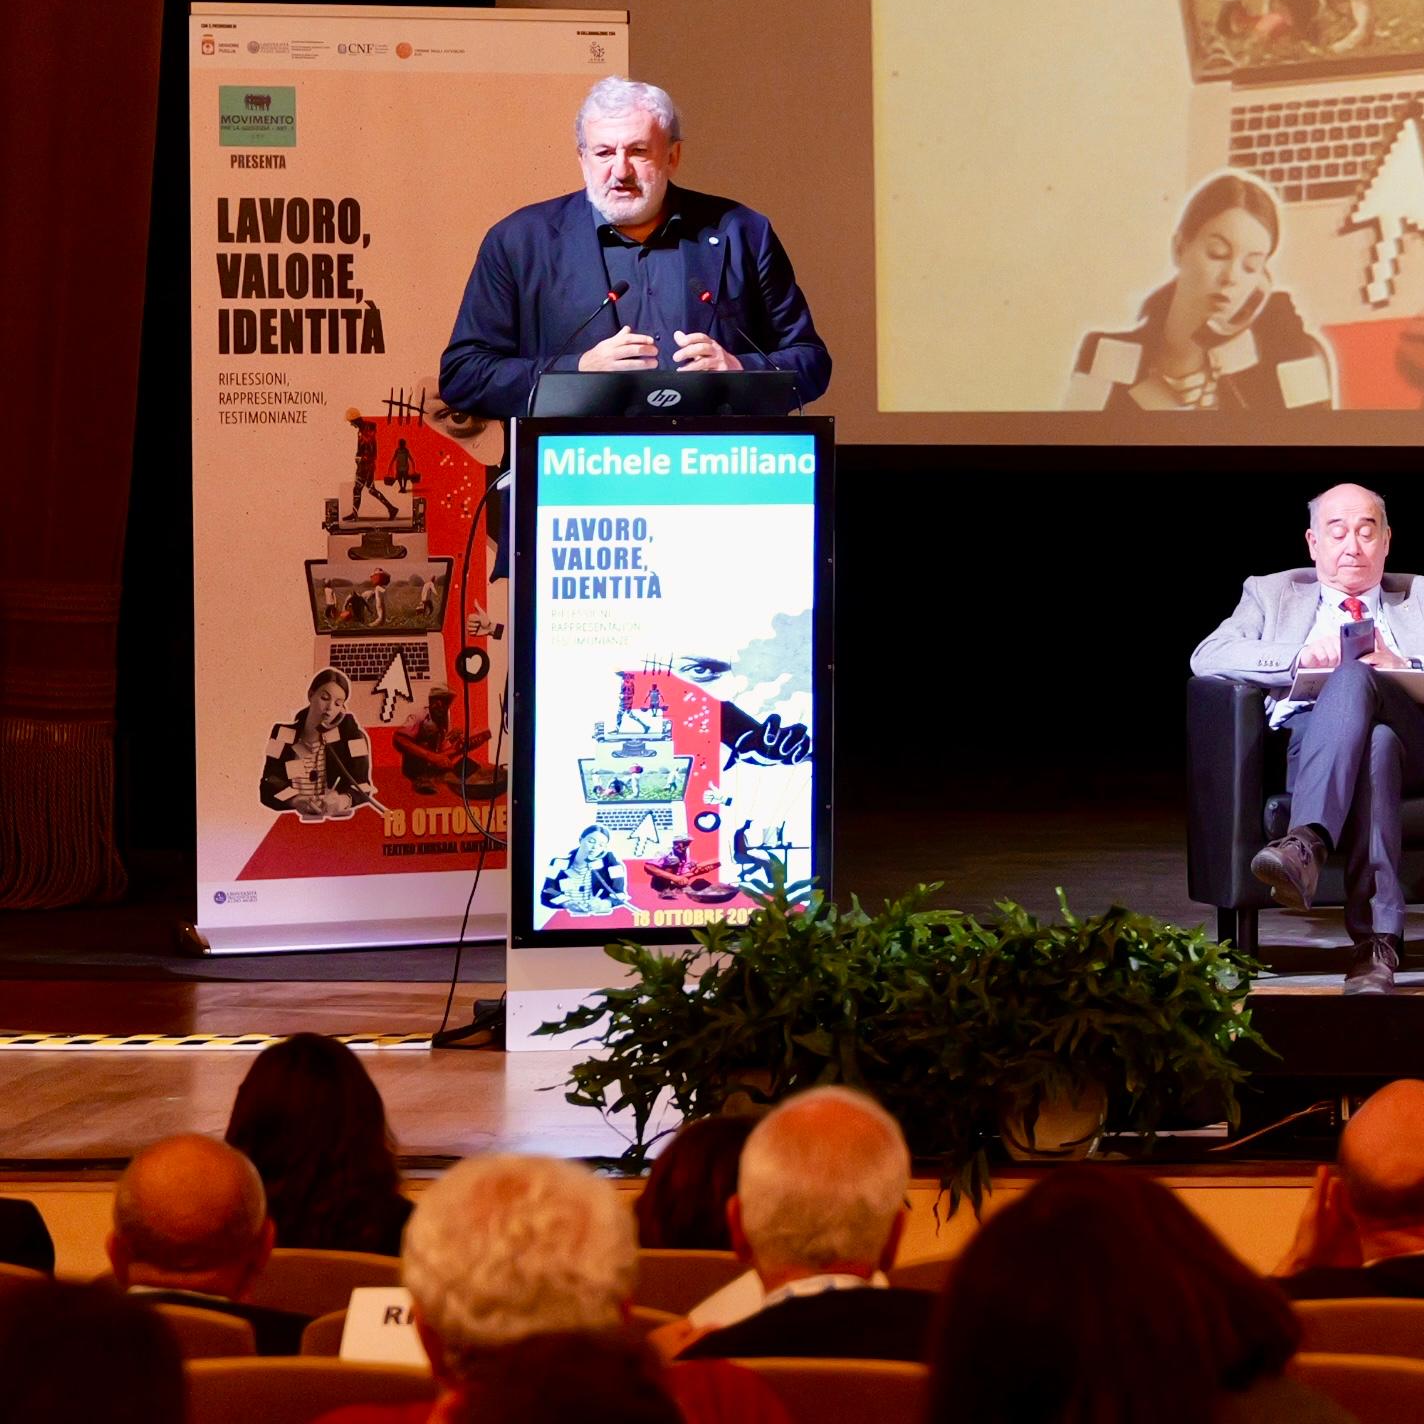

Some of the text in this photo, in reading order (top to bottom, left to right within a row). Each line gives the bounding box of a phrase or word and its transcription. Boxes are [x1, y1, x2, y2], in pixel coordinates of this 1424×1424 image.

[348, 43, 374, 54] CNF
[221, 115, 294, 125] MOVIMENTO
[230, 154, 286, 169] PRESENTA
[216, 197, 371, 249] LAVORO,
[216, 253, 364, 305] VALORE,
[218, 300, 385, 355] IDENTITÀ
[218, 372, 291, 389] RIFLESSIONI,
[218, 390, 328, 408] RAPPRESENTAZIONI,
[649, 389, 680, 407] hp
[218, 410, 308, 425] TESTIMONIANZE
[542, 445, 815, 476] Michele Emiliano
[552, 517, 654, 543] LAVORO,
[552, 547, 649, 574] VALORE,
[552, 571, 662, 600] IDENTITÀ
[384, 805, 507, 837] 18 OTTOBRE
[632, 909, 650, 926] 18
